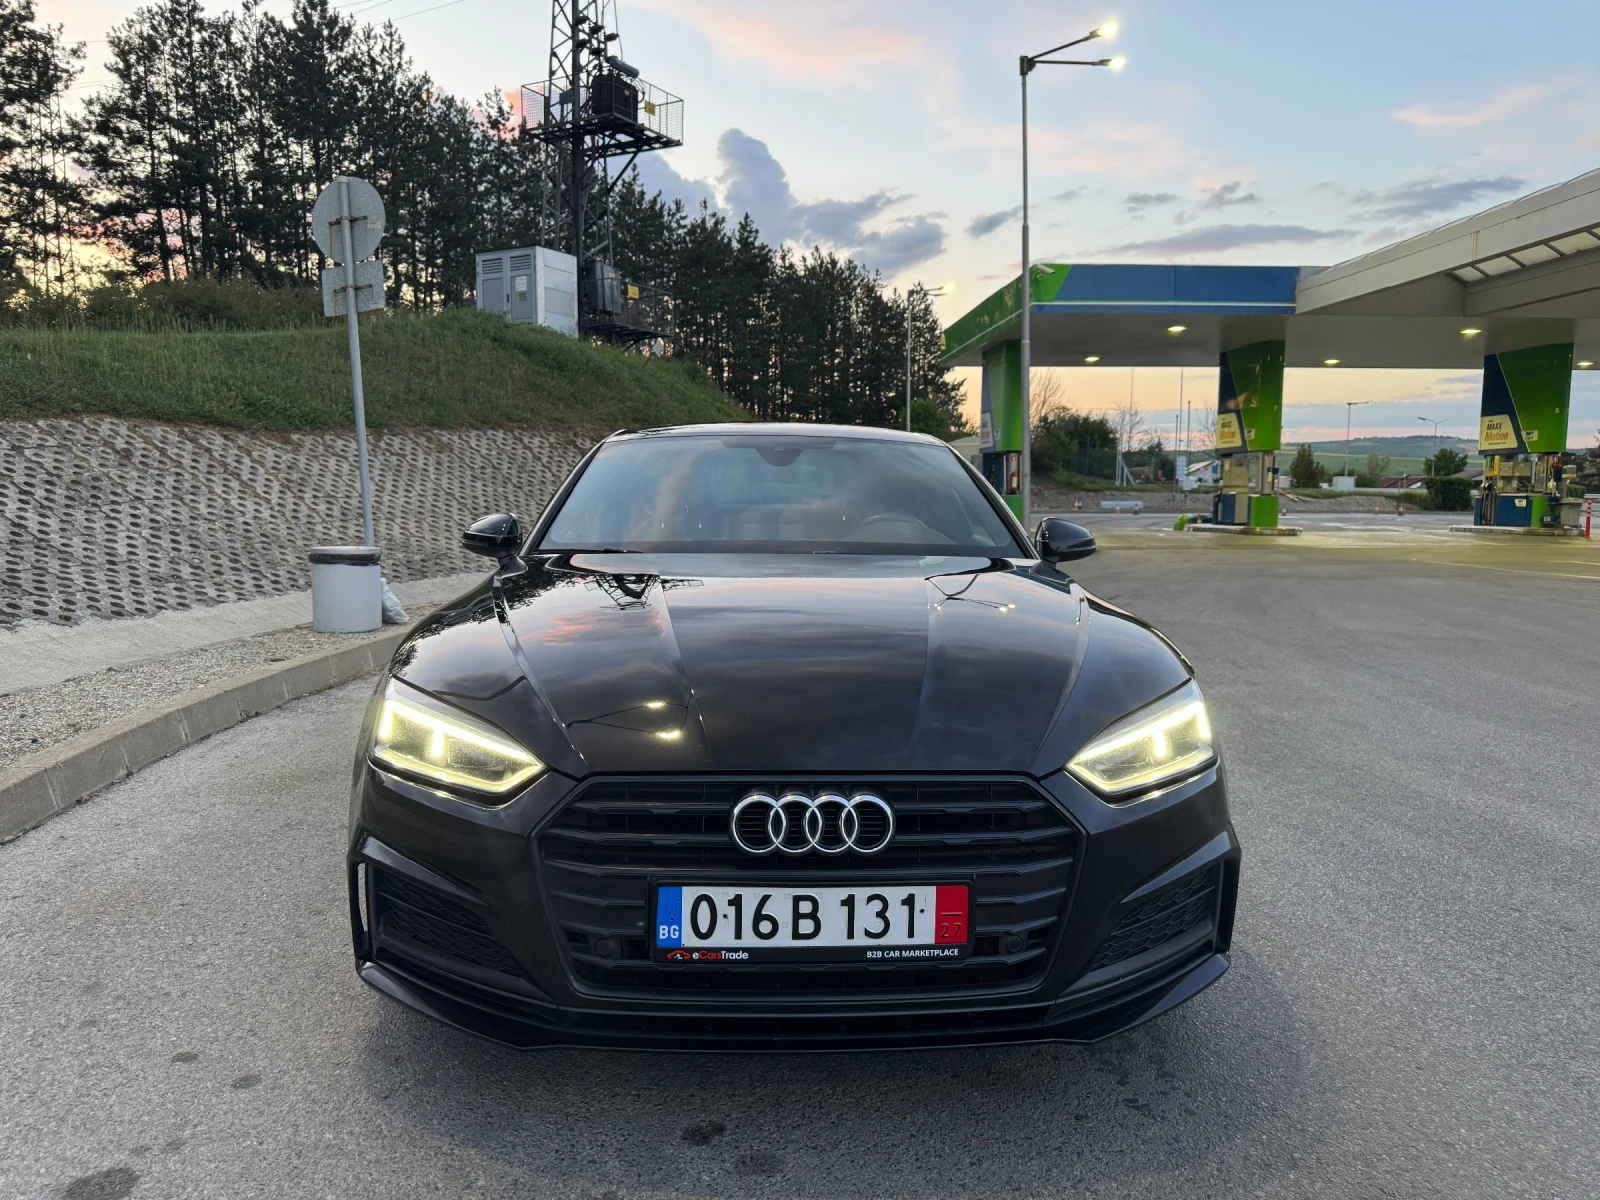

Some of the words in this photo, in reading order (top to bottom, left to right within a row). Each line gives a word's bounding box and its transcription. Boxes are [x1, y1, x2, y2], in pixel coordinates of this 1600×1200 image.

[1487, 422, 1503, 430] MAXX
[1485, 431, 1509, 441] Motion
[840, 893, 915, 940] 131
[659, 925, 680, 940] BG
[940, 922, 962, 939] 27
[692, 950, 749, 960] eCarsTrade
[866, 950, 882, 958] B2B
[884, 950, 900, 958] CAR
[902, 948, 959, 958] MARKETPLACE
